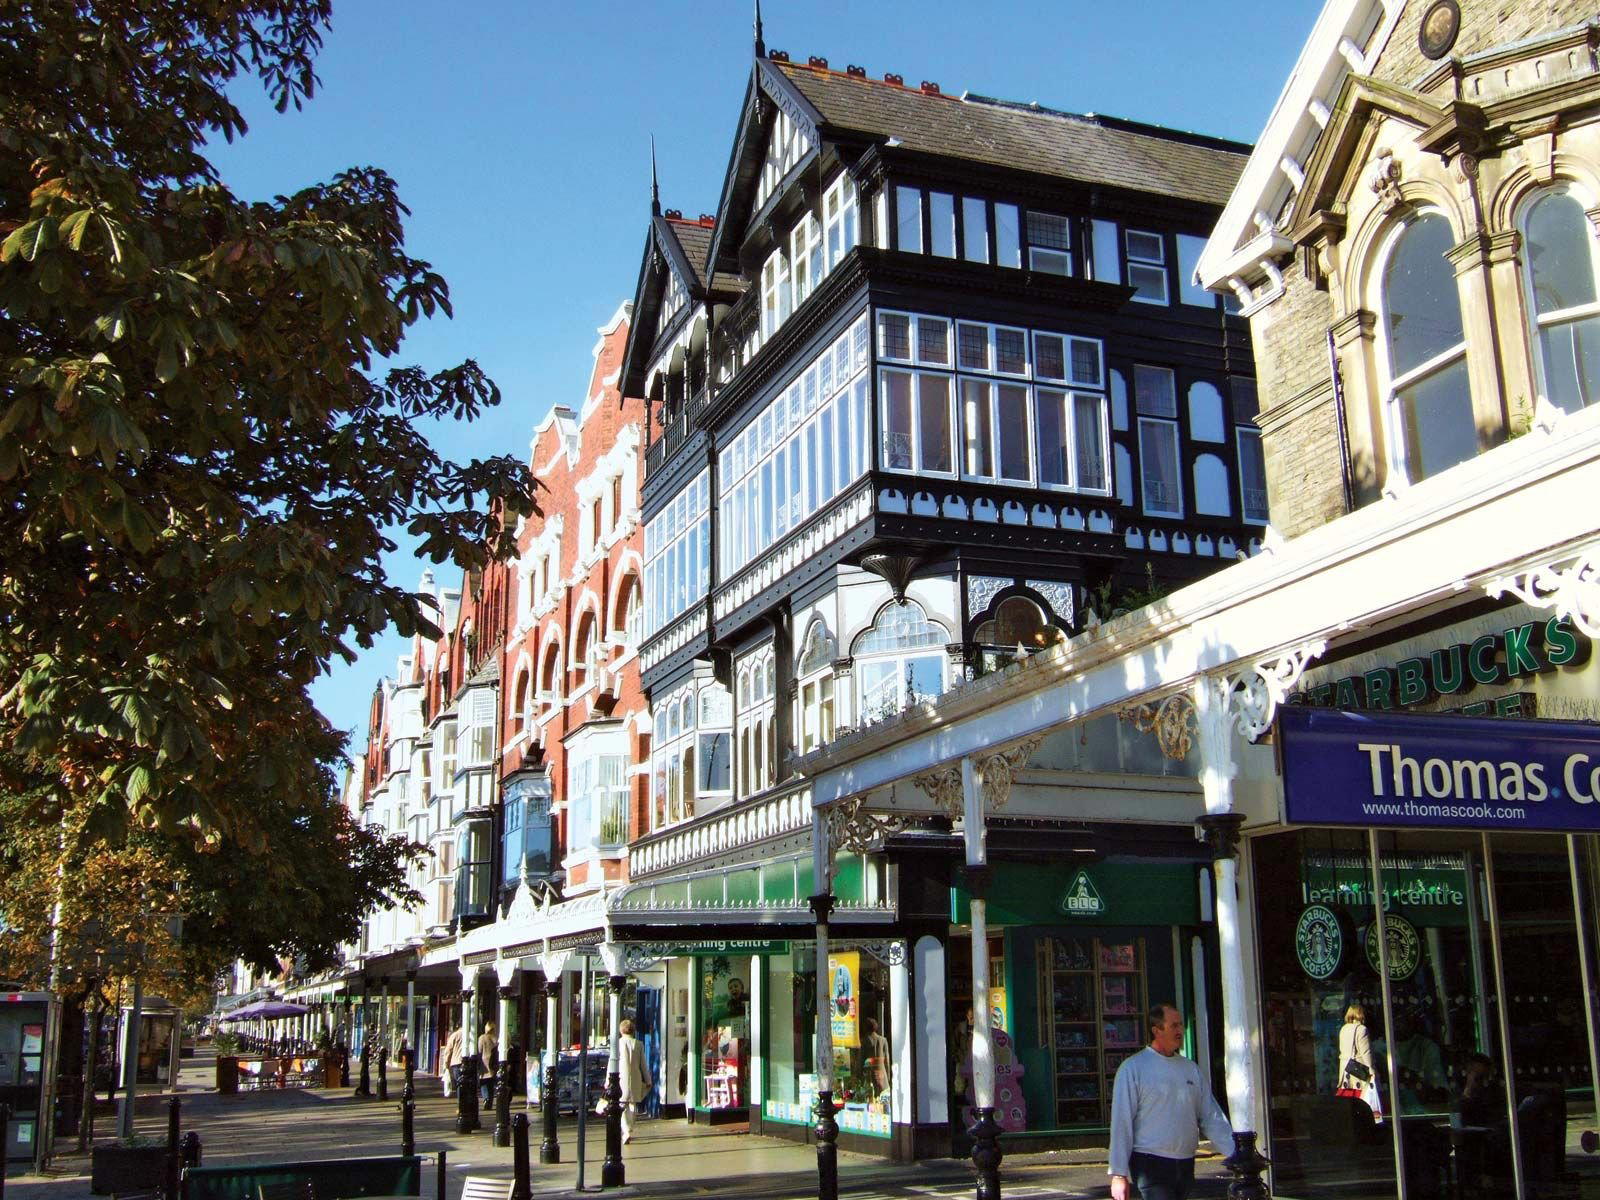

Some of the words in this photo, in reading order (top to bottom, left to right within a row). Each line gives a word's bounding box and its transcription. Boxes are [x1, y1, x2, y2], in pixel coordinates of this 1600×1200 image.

[1358, 743, 1549, 802] Thomas
[1362, 801, 1525, 819] www.thomascook.com
[1069, 898, 1098, 909] ELC
[1401, 888, 1464, 905] centre
[1298, 909, 1339, 942] STARBUCKS
[730, 940, 770, 948] centre
[1304, 955, 1337, 975] COFFEE
[1375, 959, 1415, 977] CFFEE
